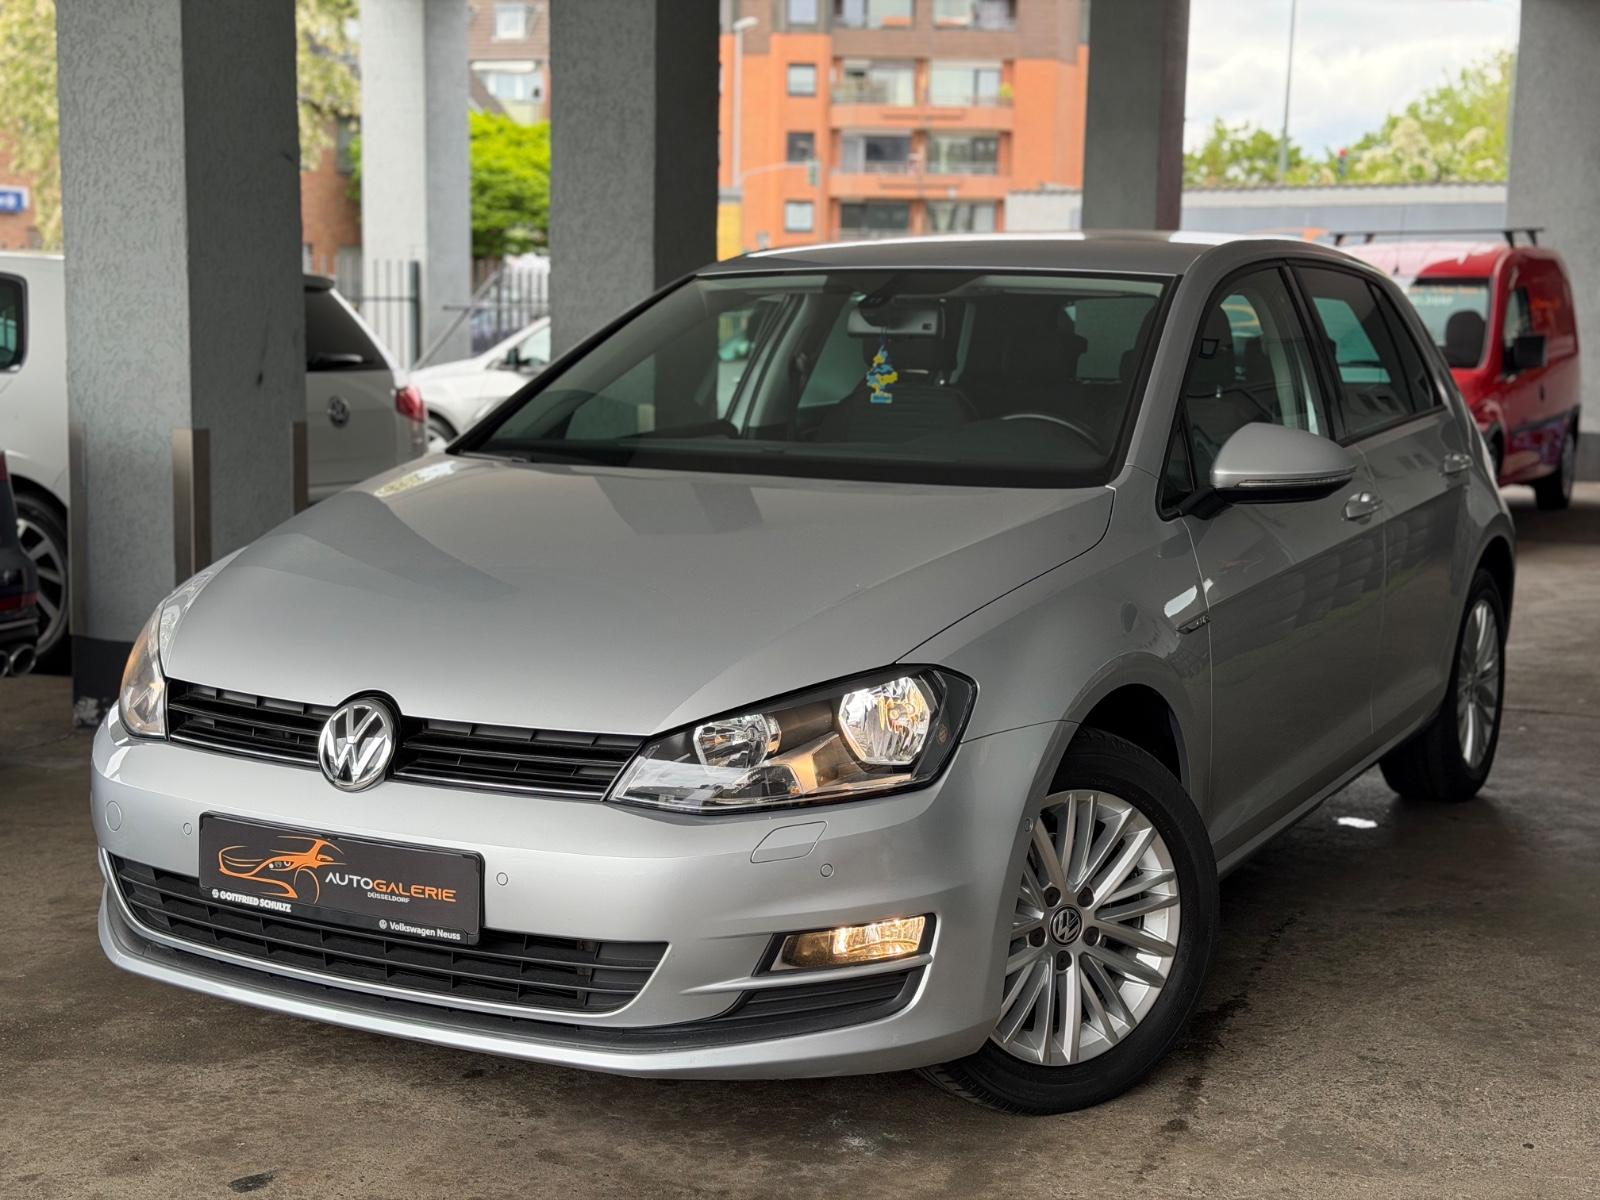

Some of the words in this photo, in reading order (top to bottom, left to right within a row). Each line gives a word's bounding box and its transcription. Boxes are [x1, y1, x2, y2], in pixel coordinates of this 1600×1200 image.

[325, 871, 457, 902] AUTOGALERIE
[220, 890, 259, 906] GOTTFRIED
[260, 898, 292, 913] SCHULTZ
[389, 921, 436, 938] Volkswagen
[436, 928, 461, 941] Neuss
